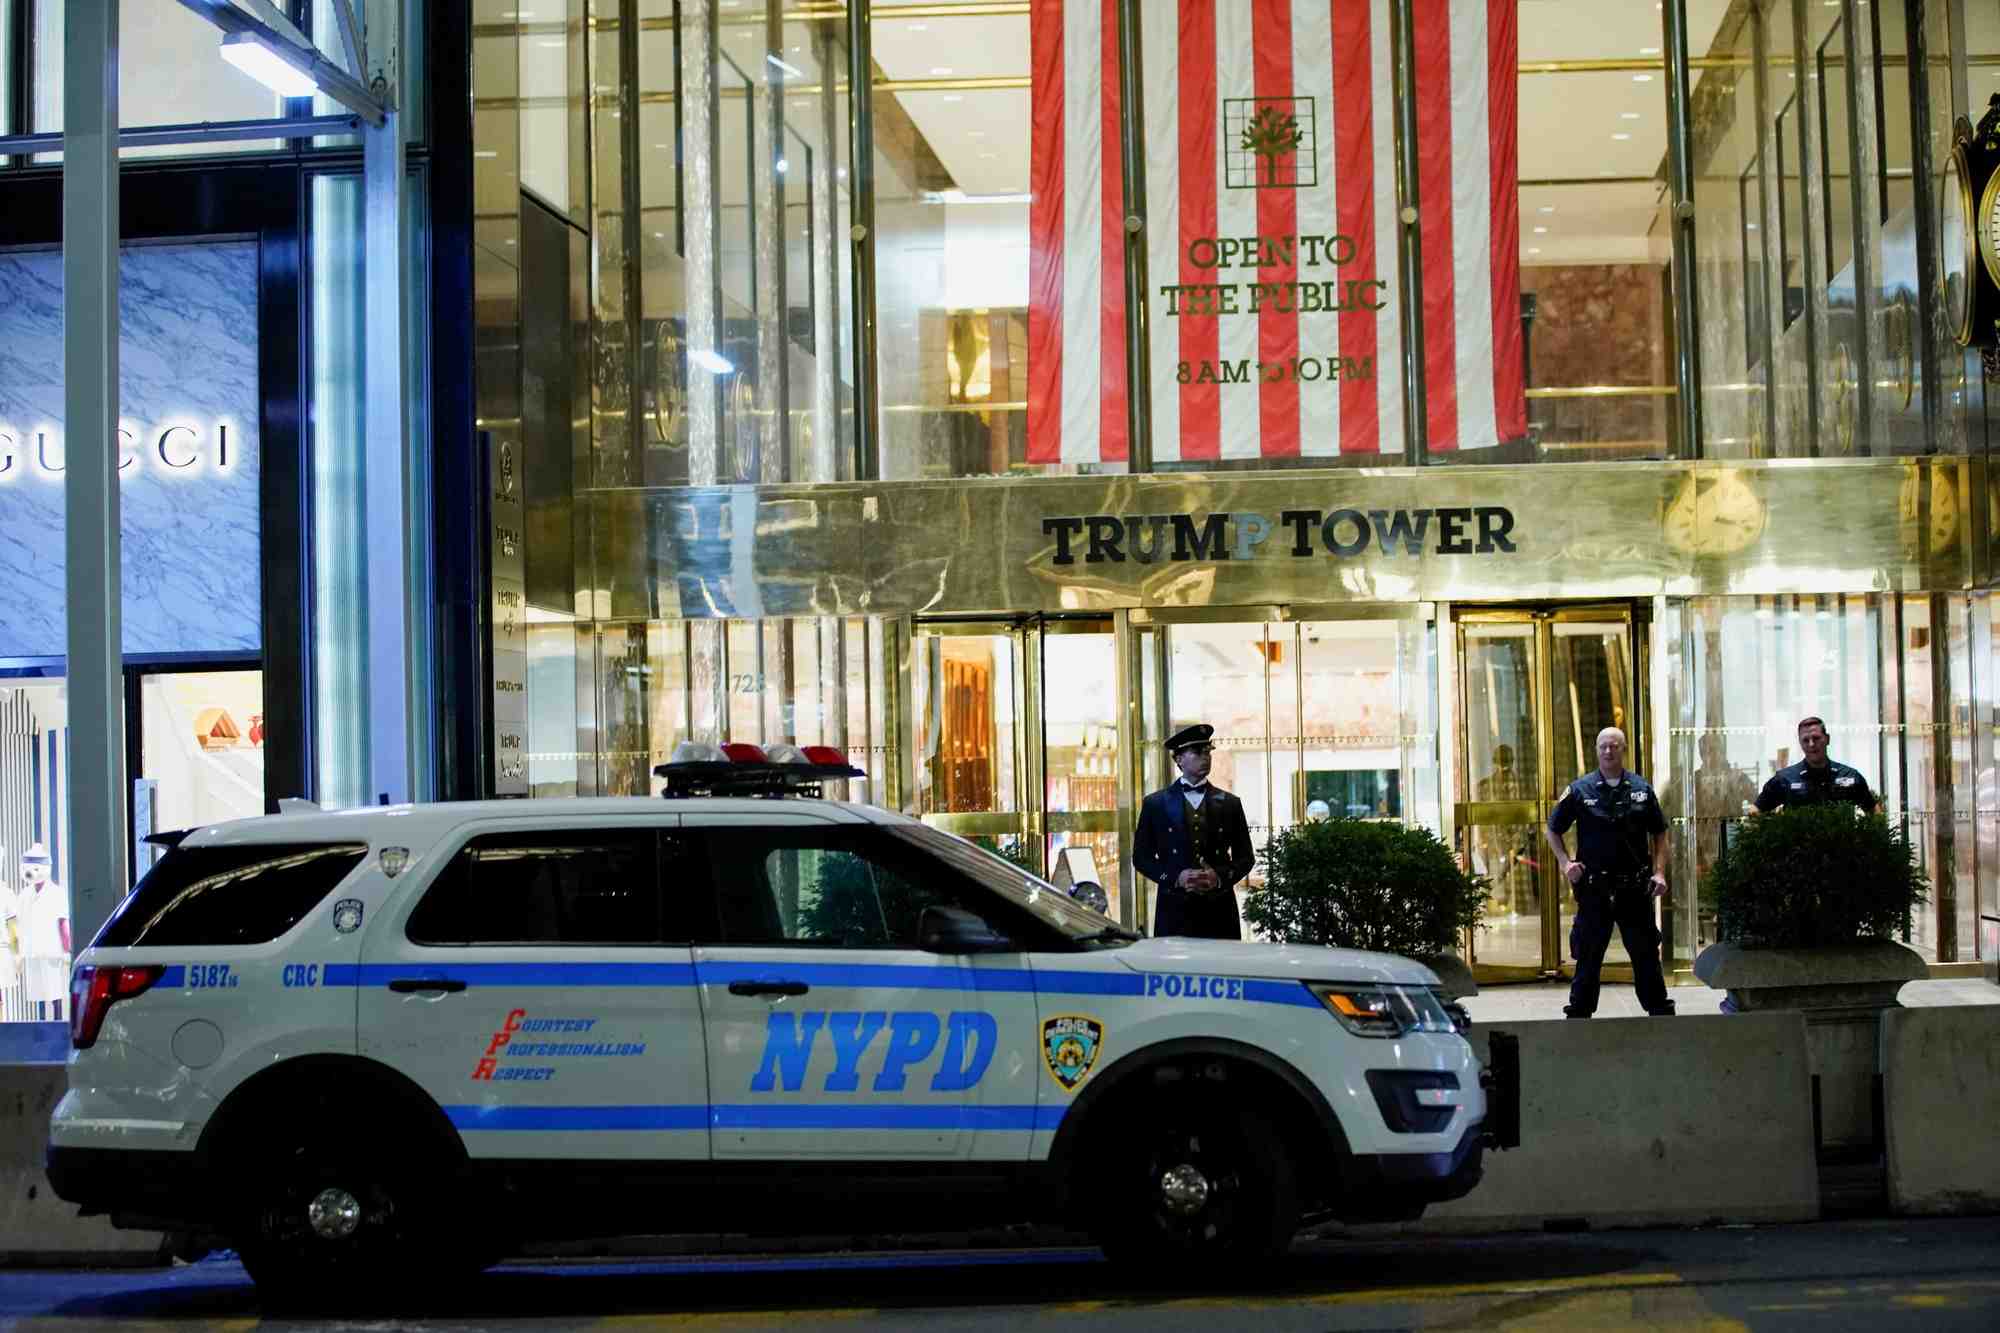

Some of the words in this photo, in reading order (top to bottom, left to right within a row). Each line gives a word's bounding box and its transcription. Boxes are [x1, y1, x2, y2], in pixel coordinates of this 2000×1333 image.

[1188, 235, 1295, 269] OPEN
[1301, 234, 1357, 267] TO
[1160, 284, 1240, 317] THE
[1247, 280, 1388, 314] PUBLIC
[1042, 512, 1271, 566] TRUMP
[1281, 505, 1518, 558] TOWER
[282, 963, 318, 987] CRC
[1147, 974, 1243, 1000] POLICE
[750, 1011, 997, 1092] NYPD
[471, 1058, 556, 1081] RESPECT
